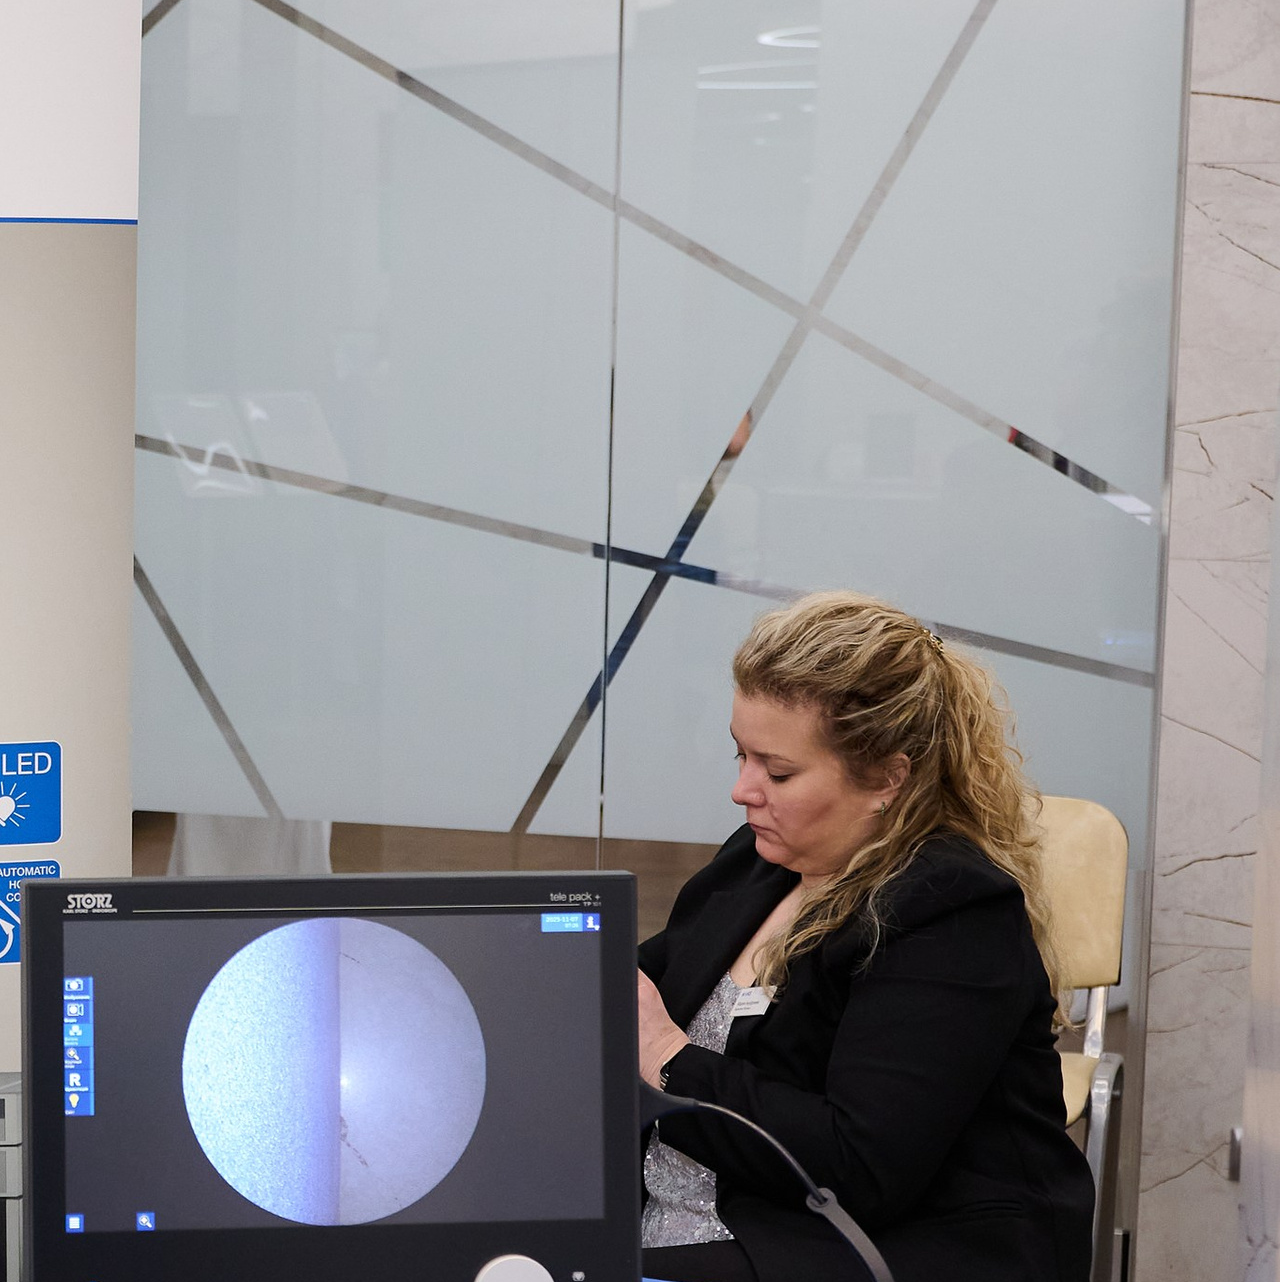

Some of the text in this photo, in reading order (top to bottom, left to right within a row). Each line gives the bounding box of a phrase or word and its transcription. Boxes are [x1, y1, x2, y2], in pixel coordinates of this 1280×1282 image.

[1, 751, 53, 777] LED
[66, 892, 113, 909] STORZ
[550, 893, 567, 901] tele
[569, 892, 592, 903] pack
